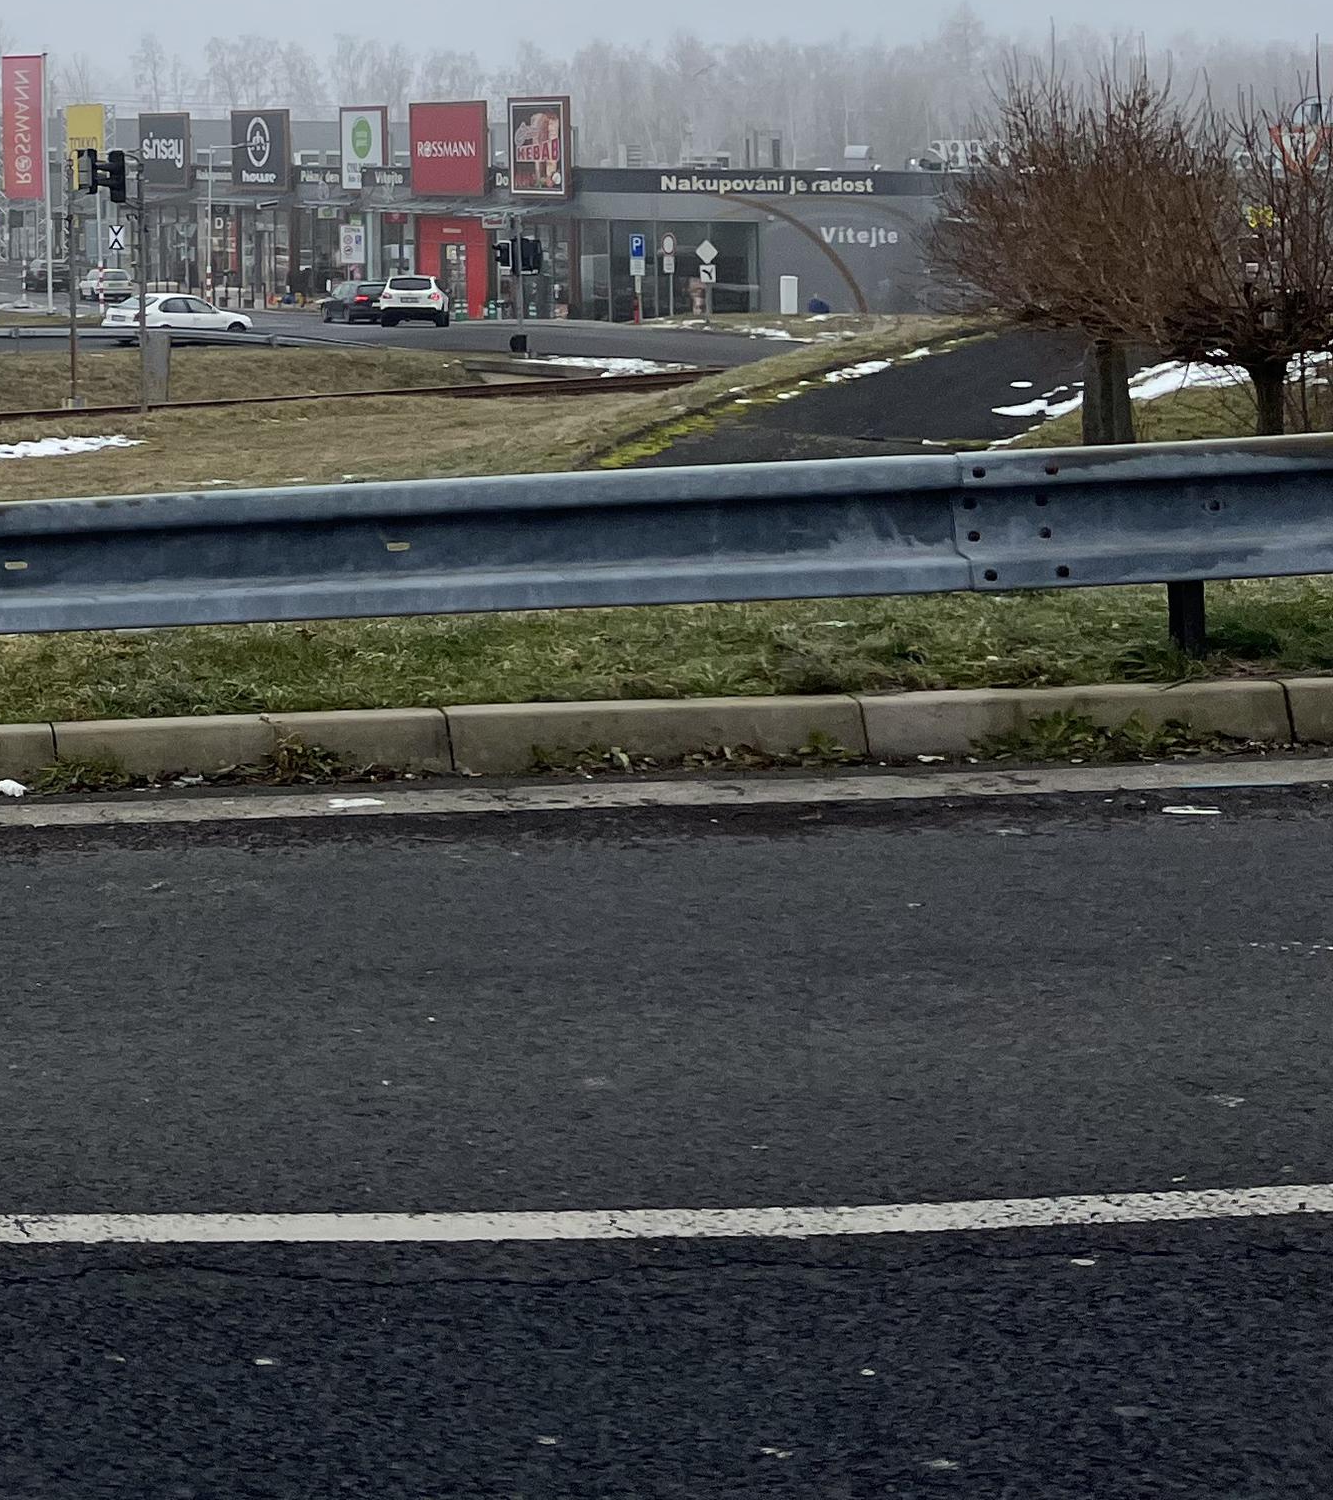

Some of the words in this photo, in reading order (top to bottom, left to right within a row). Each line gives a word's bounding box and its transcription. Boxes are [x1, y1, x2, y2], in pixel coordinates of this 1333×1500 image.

[142, 132, 183, 168] sinsay
[417, 141, 476, 158] ROSSMANN
[242, 170, 277, 183] house
[661, 175, 784, 194] Nakupování
[789, 177, 808, 195] je
[812, 177, 874, 193] radost
